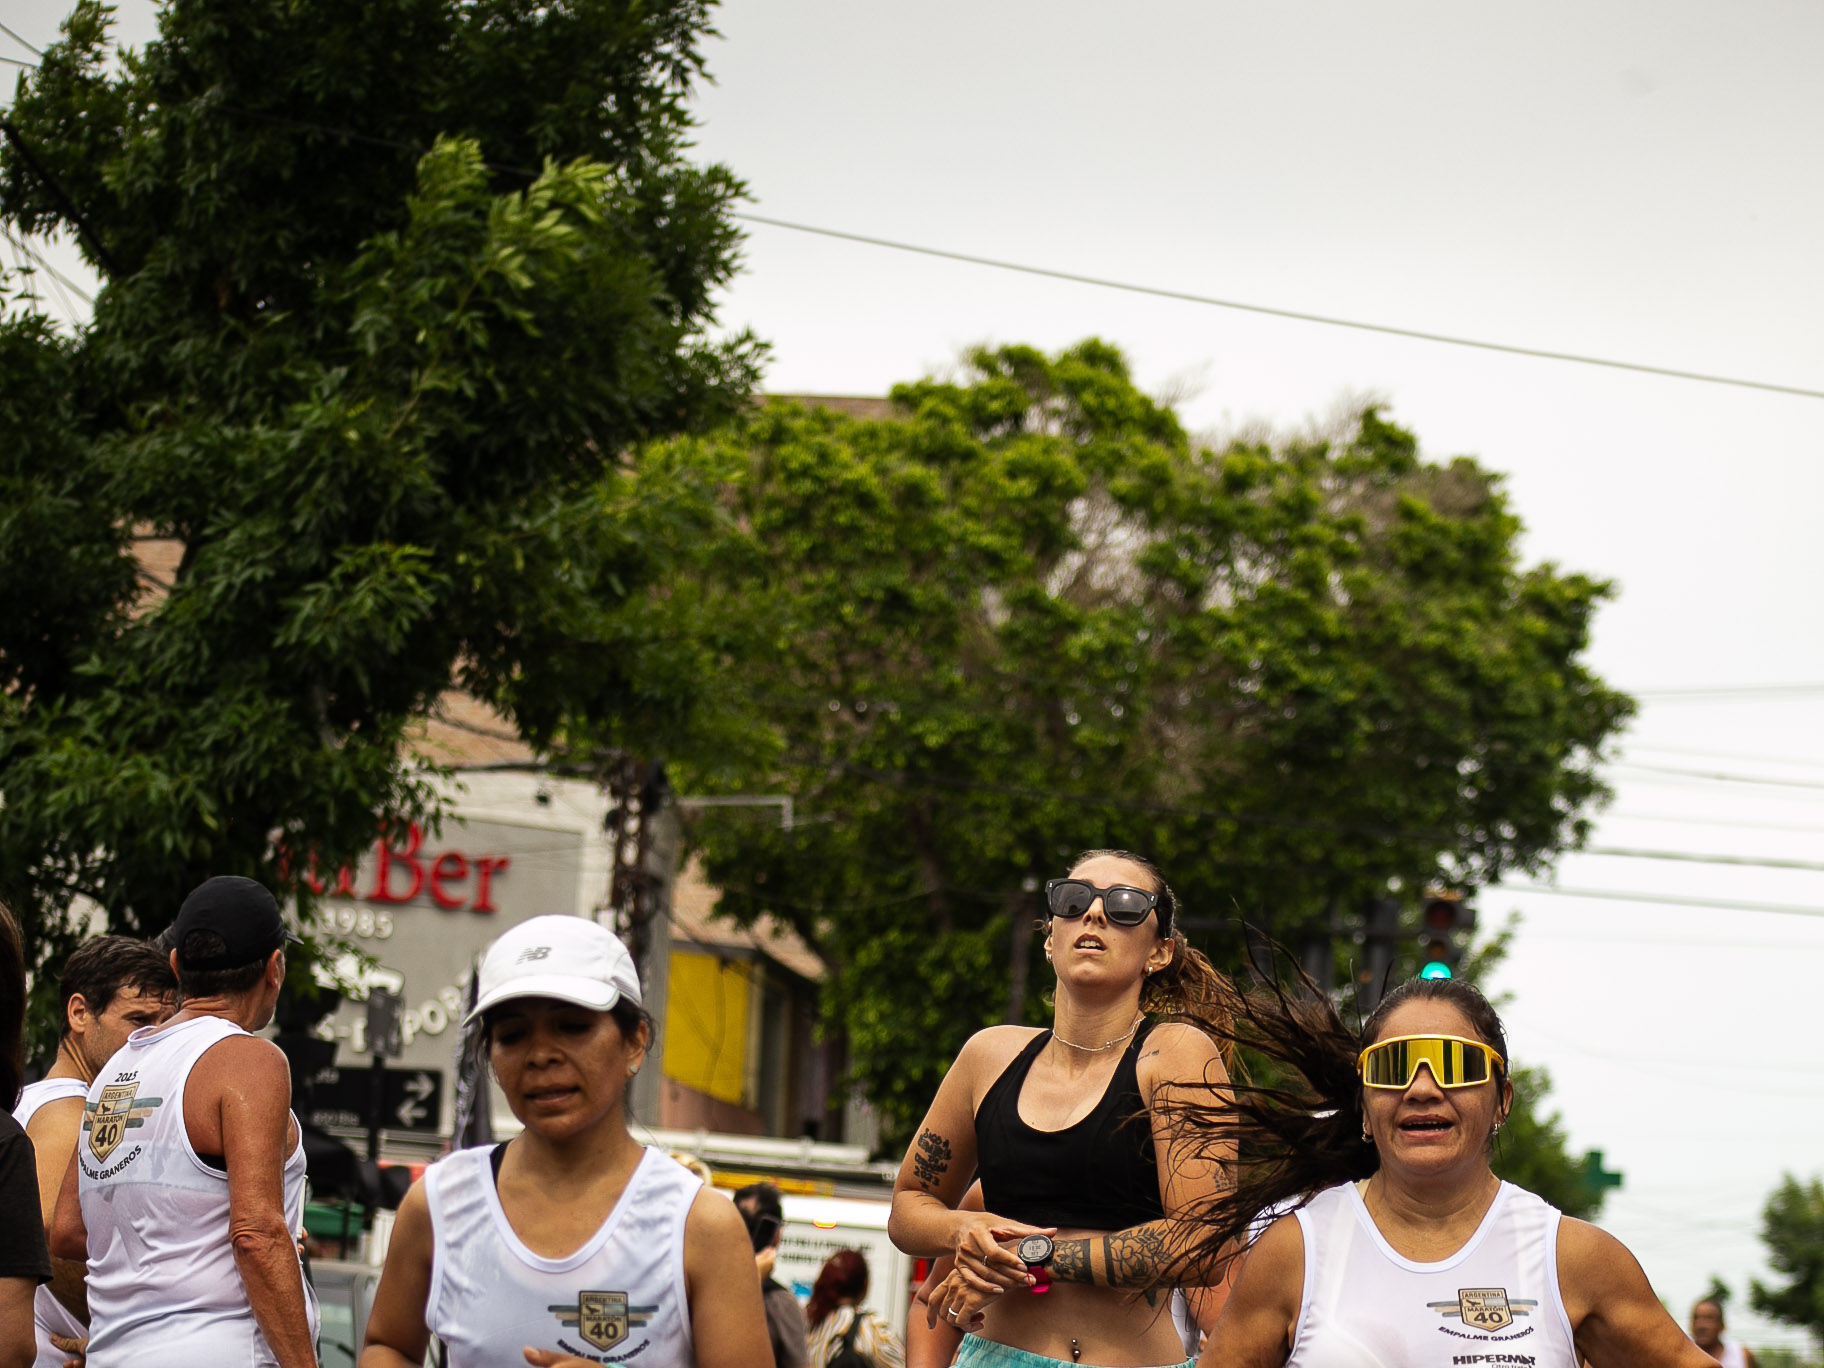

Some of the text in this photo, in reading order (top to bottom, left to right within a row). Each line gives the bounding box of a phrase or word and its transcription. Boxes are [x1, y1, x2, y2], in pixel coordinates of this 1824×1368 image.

[94, 1123, 118, 1148] 40
[100, 1144, 142, 1180] GRANEROS
[1474, 1312, 1503, 1324] 40
[590, 1322, 619, 1340] 40
[1438, 1326, 1534, 1341] EMPALME GRANEROS
